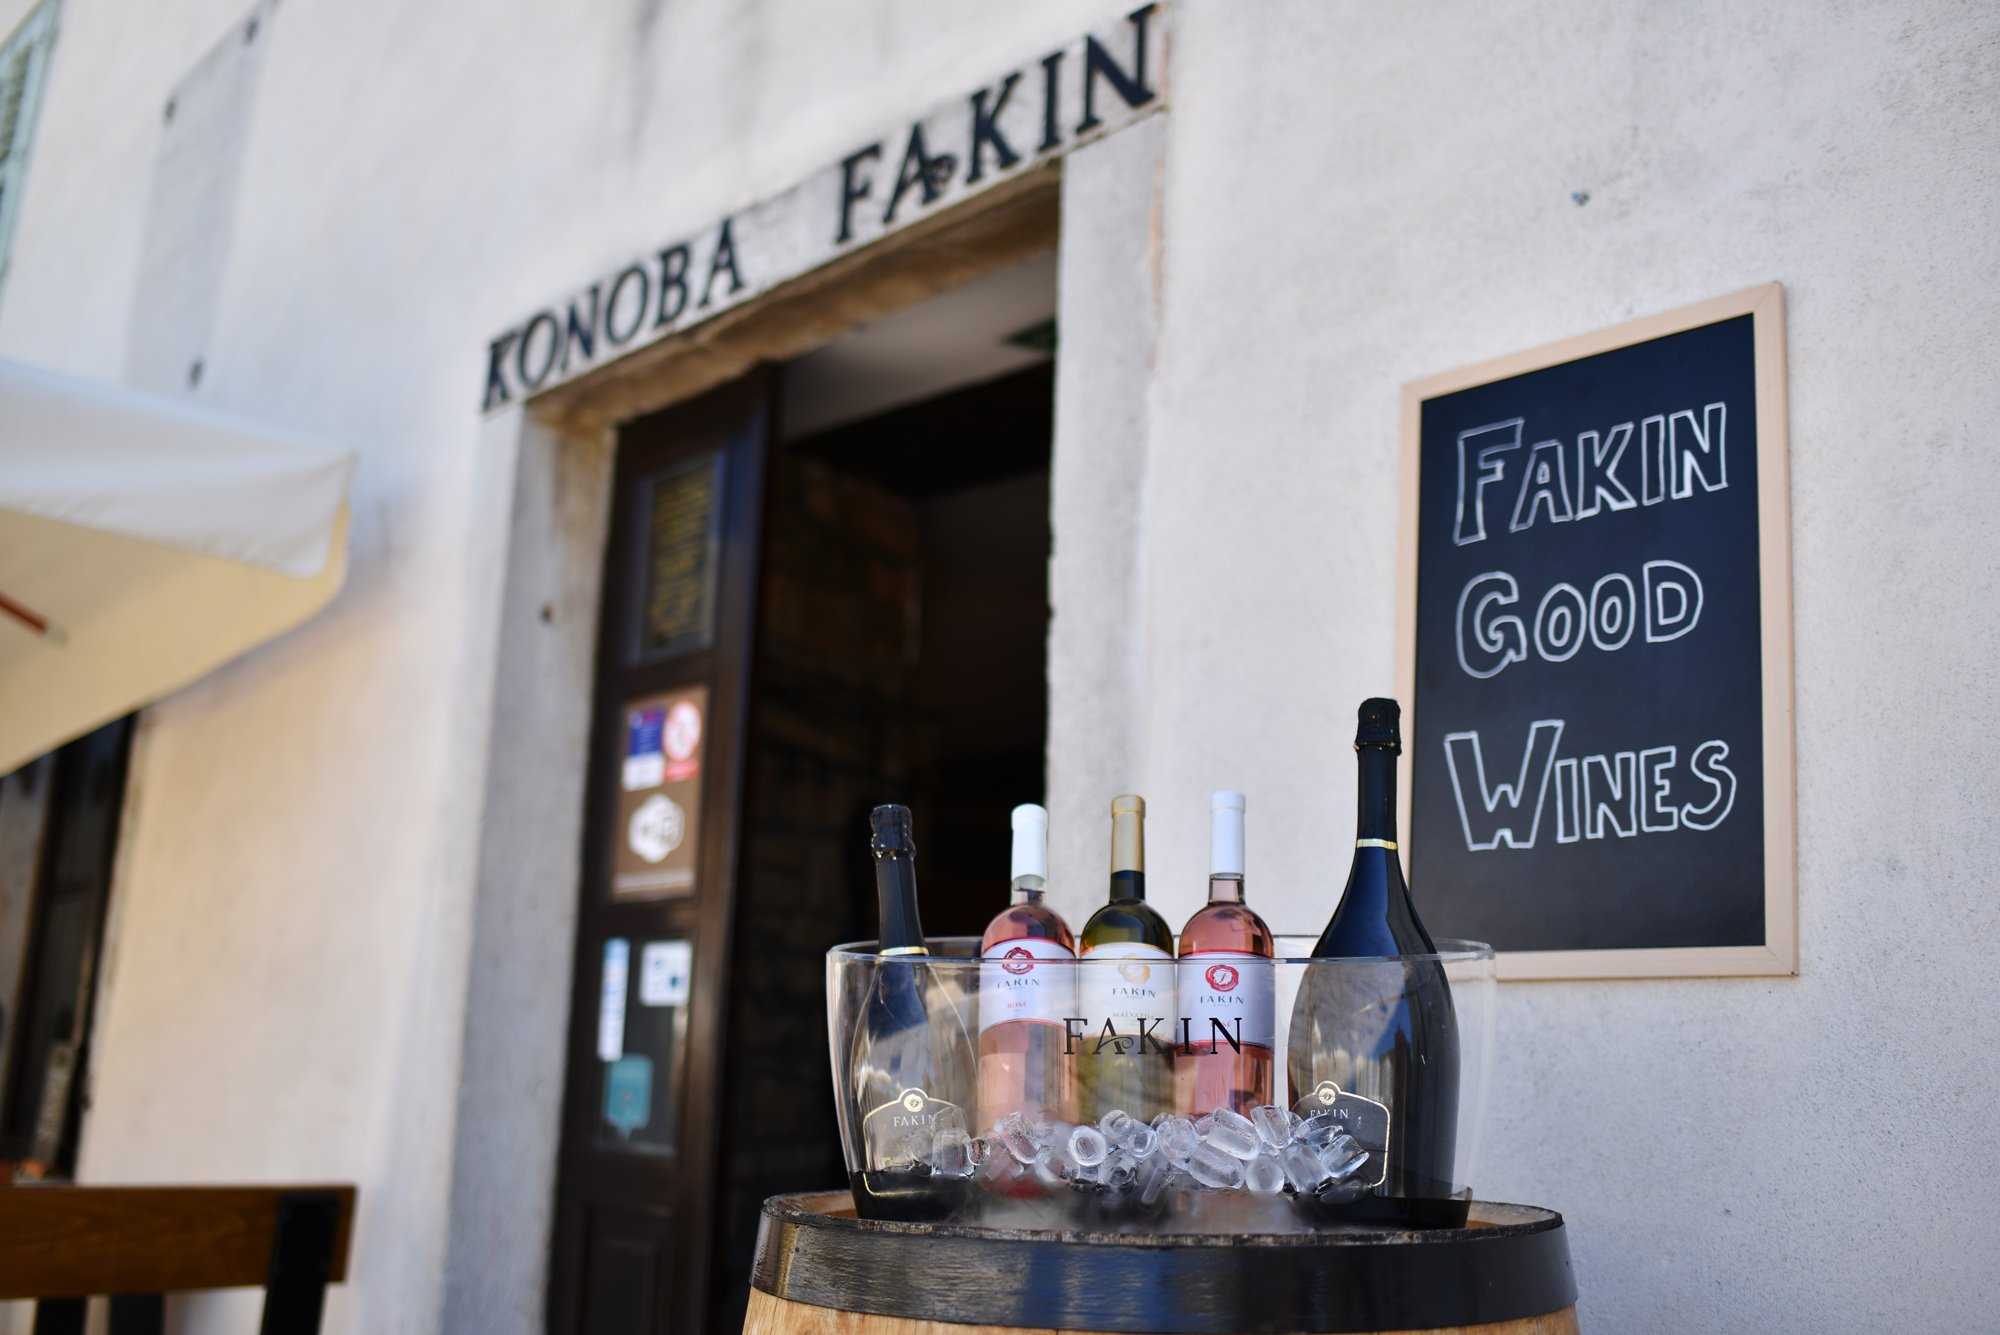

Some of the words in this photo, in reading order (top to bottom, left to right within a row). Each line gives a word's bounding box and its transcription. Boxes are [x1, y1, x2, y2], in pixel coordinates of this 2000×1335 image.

[482, 216, 745, 412] KONOBA
[834, 2, 1160, 246] FAKIN
[1453, 401, 1728, 546] FAKIN
[1455, 559, 1704, 679] GOOD
[1443, 719, 1737, 852] WINES
[1112, 987, 1157, 998] FAKIN
[1200, 995, 1245, 1005] FAKIN
[1063, 1016, 1243, 1055] FAKIN
[893, 1114, 935, 1128] FAKIN
